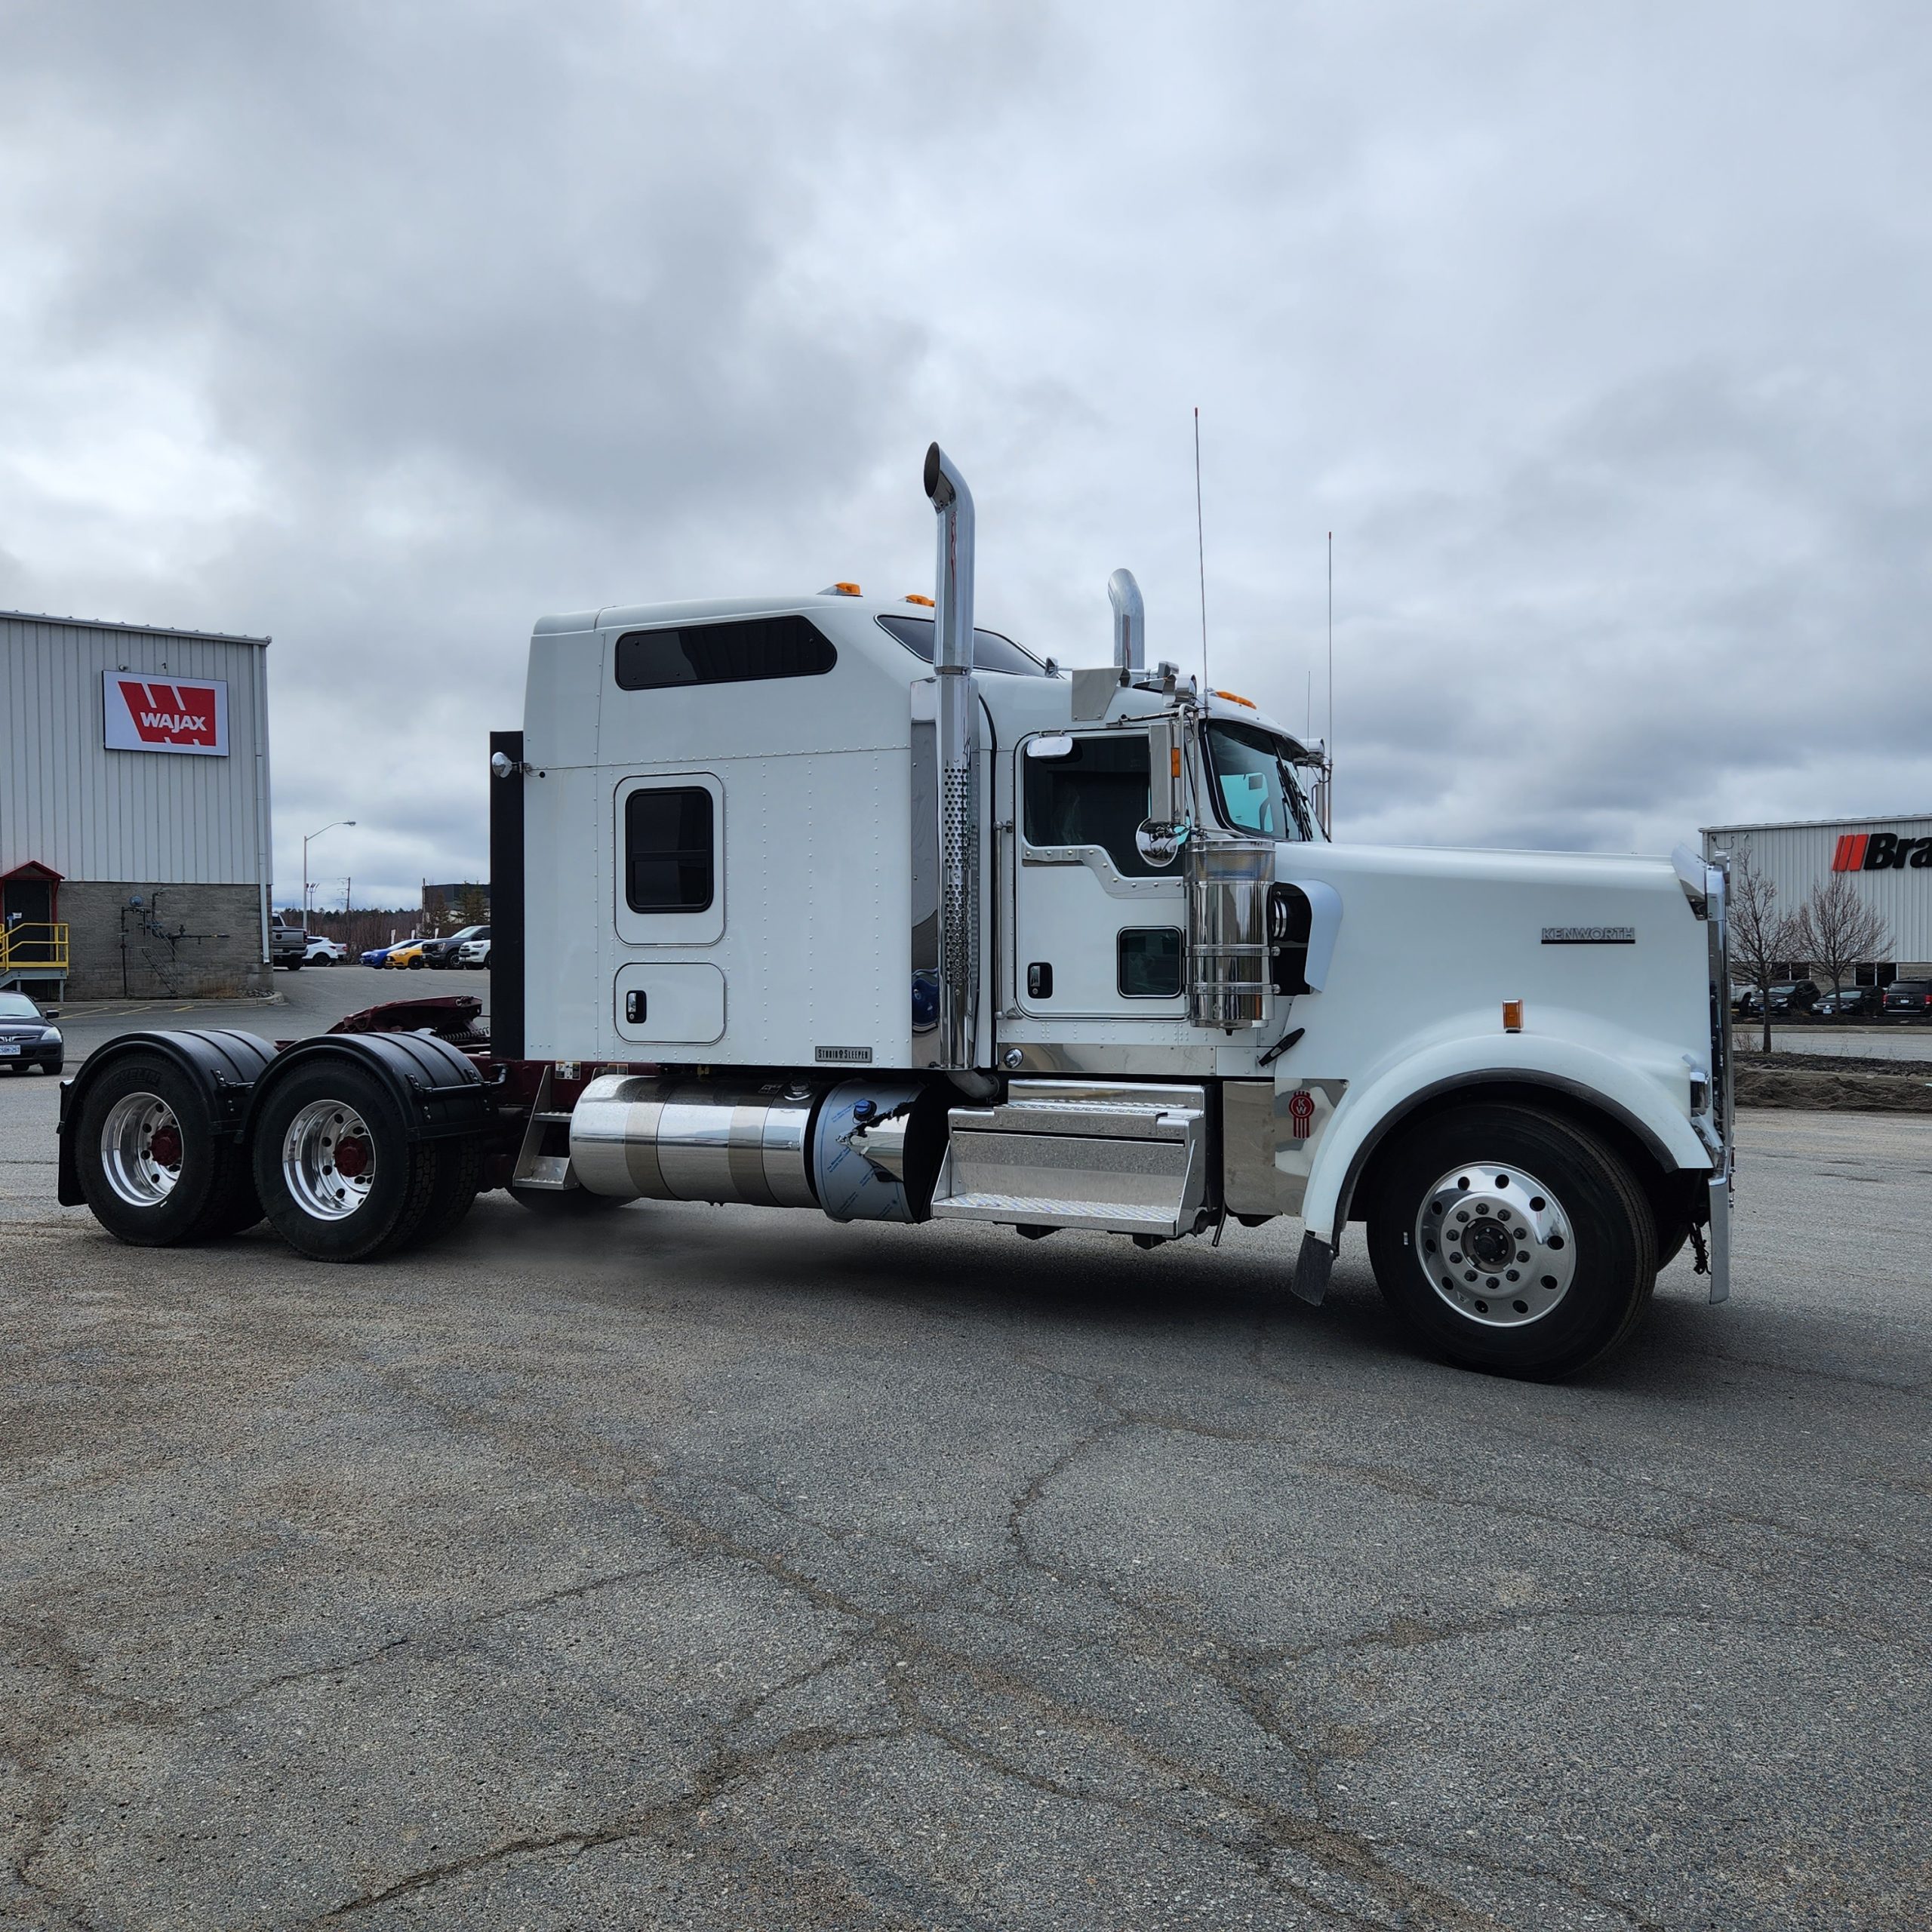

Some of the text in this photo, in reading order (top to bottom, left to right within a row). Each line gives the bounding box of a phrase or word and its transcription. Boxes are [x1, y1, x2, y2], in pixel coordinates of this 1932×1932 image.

[140, 712, 208, 734] WAJAX
[1863, 832, 1932, 870] Bra
[1542, 928, 1635, 940] KENWORTH
[844, 1050, 868, 1059] SLEEPER
